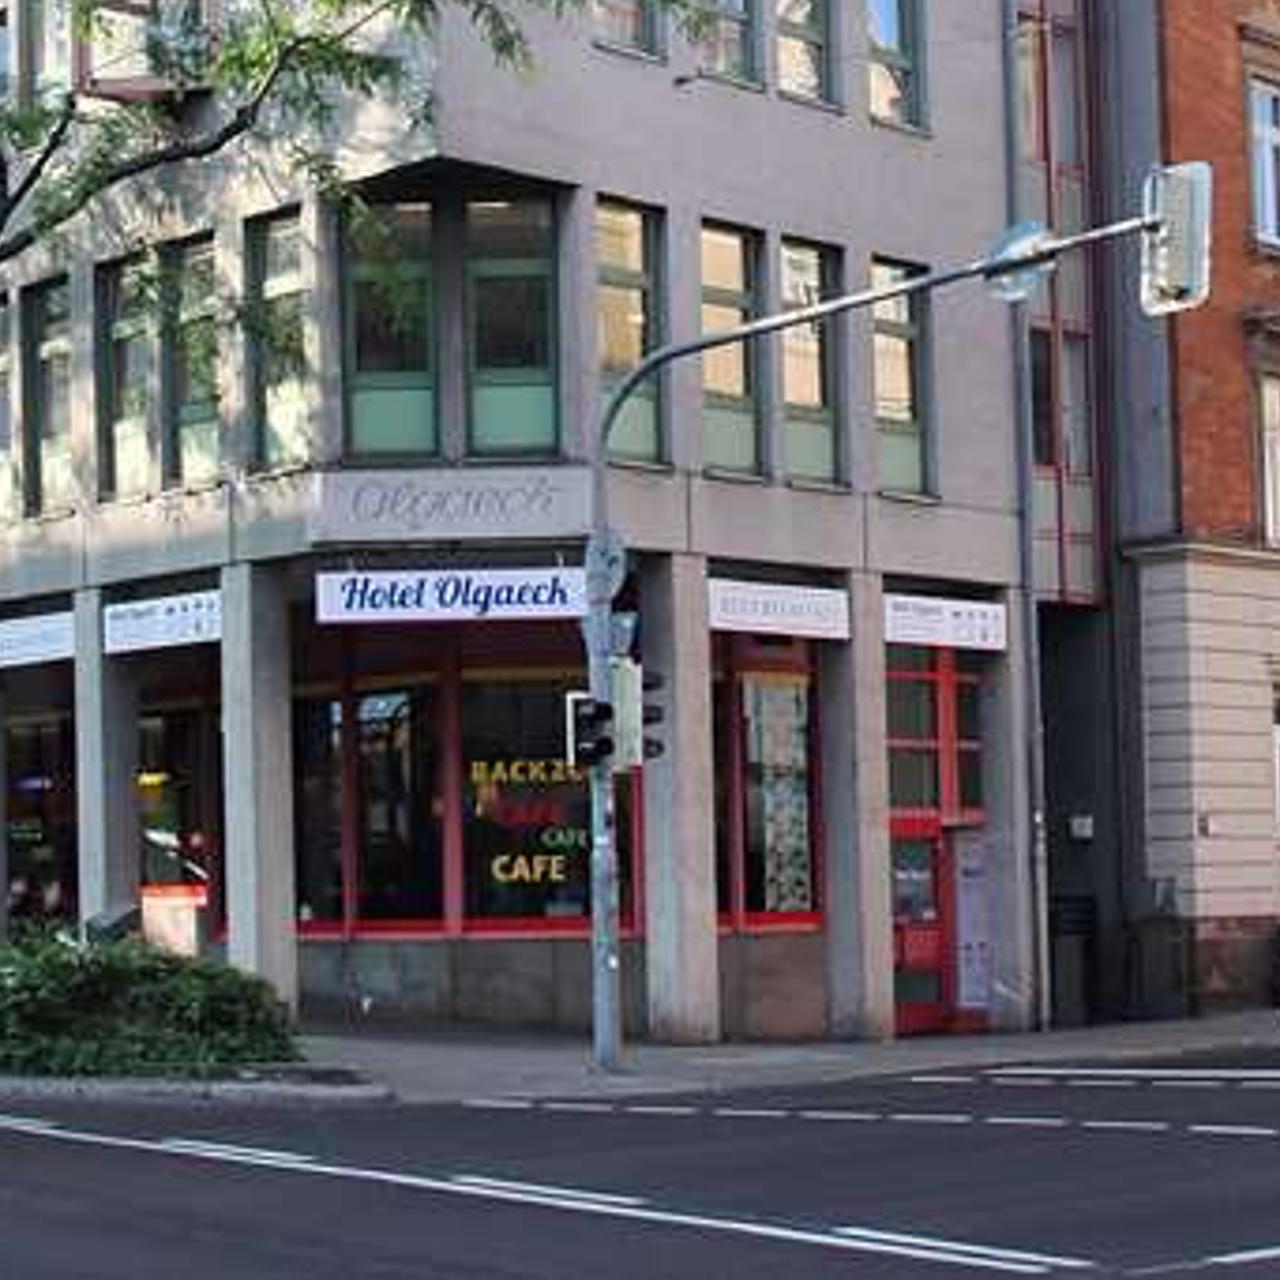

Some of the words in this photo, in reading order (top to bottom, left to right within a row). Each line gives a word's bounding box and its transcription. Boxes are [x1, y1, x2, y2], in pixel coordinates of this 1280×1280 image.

[340, 576, 426, 610] Hotel
[434, 575, 569, 616] Olgaeck
[490, 854, 566, 882] CAFE
